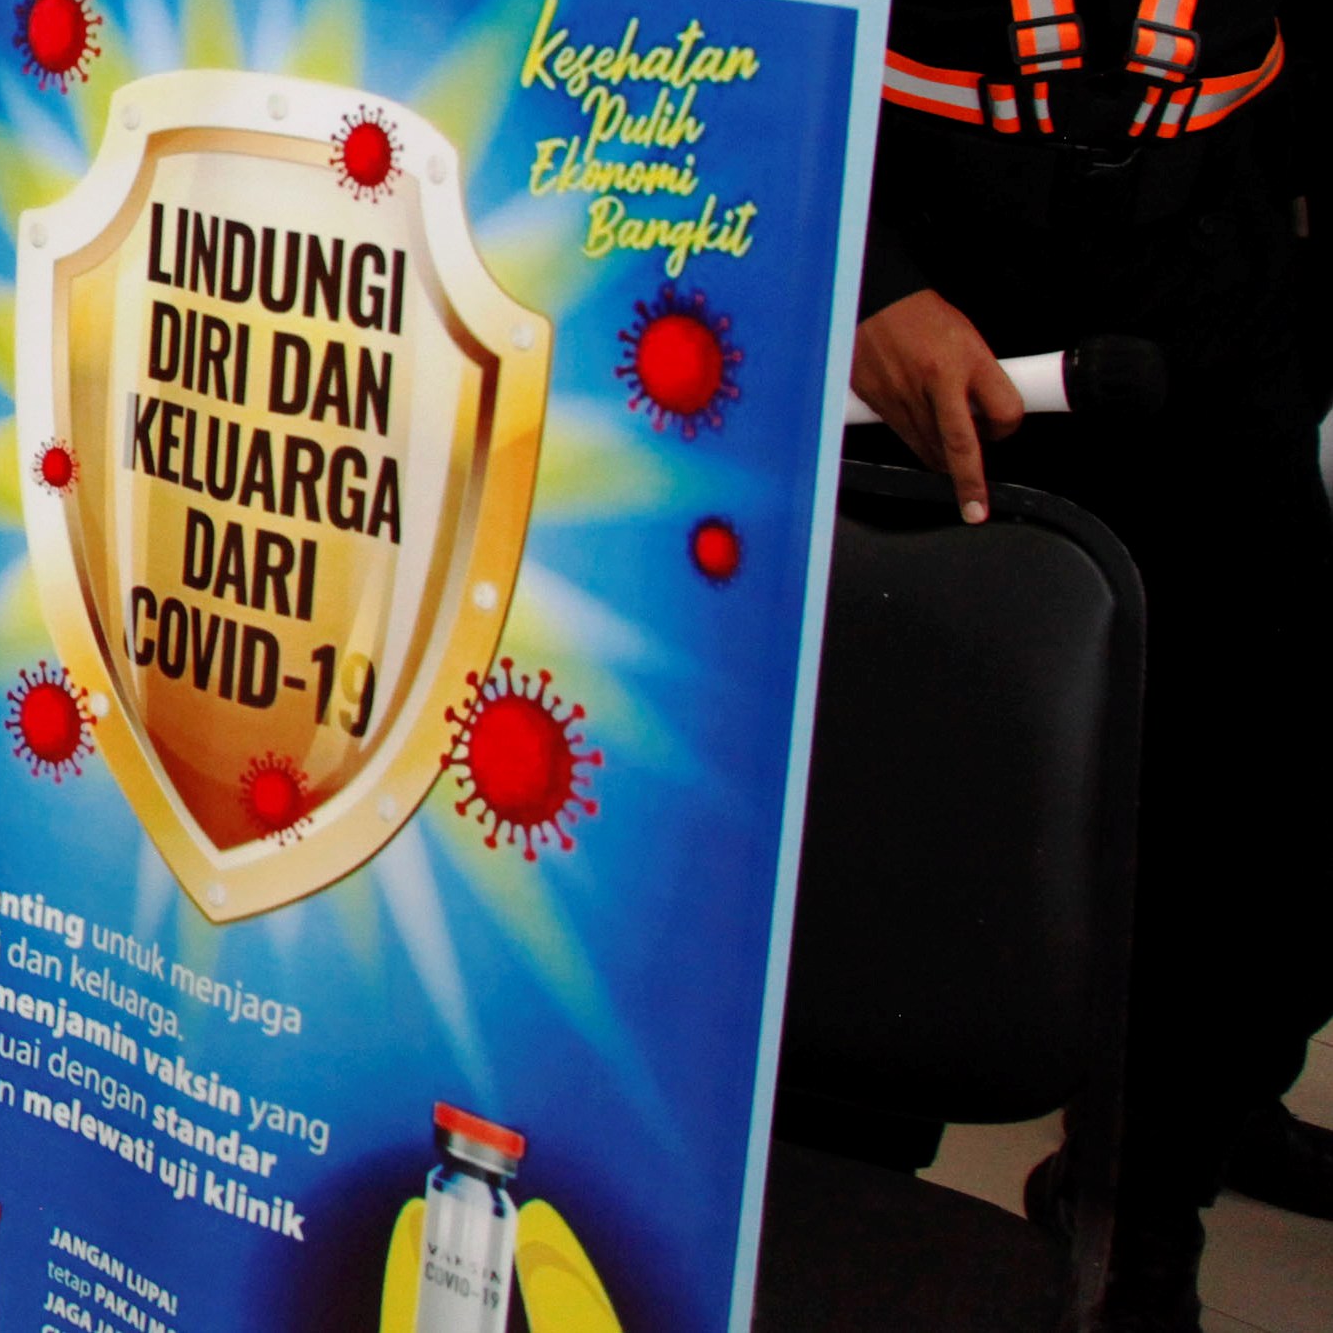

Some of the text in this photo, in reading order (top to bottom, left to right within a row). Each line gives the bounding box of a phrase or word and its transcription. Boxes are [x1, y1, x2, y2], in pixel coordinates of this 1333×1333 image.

[529, 136, 698, 196] Ekonomi
[582, 84, 705, 162] Pulih
[147, 203, 405, 334] LINDUNGI
[582, 195, 757, 278] Bangkit
[148, 302, 392, 436] DIRI DAN
[125, 393, 401, 545] KELUARGA
[182, 507, 317, 620] DARI
[125, 586, 377, 737] COVID-19
[8, 935, 62, 981] dan
[70, 952, 184, 1042] keluarga.
[92, 922, 164, 981] untuk
[170, 960, 302, 1037] menjaga
[47, 1041, 146, 1119] dengan
[153, 1102, 277, 1179] standar
[143, 1046, 240, 1116] vaksin
[249, 1095, 330, 1155] yang
[23, 1089, 153, 1173] melewati
[158, 1149, 198, 1201] uji
[202, 1168, 305, 1242] klinik
[43, 1291, 92, 1333] JAGA
[47, 1260, 146, 1333] tetap PAKAI
[49, 1226, 178, 1317] JANGAN LUPA!
[425, 1261, 500, 1309] COVID-19
